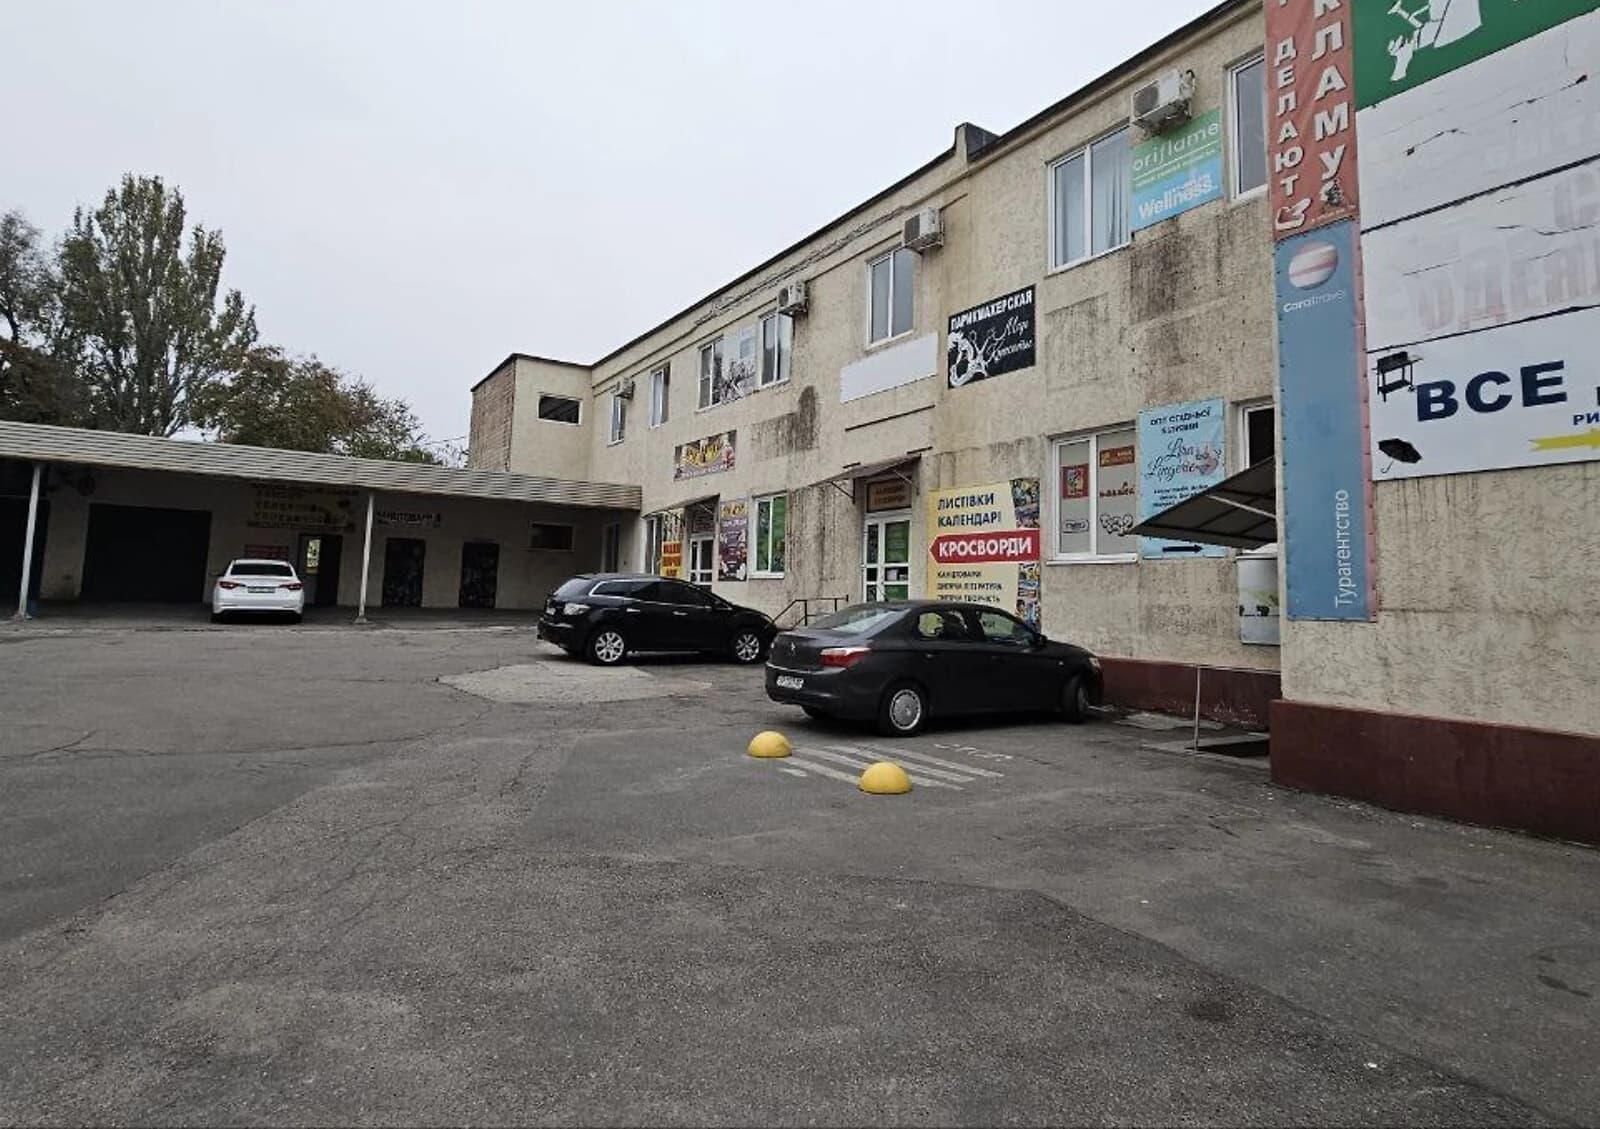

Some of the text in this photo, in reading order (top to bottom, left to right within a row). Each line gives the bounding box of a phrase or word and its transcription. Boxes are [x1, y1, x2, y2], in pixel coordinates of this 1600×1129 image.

[1273, 35, 1304, 196] ДЕЛАЮТ
[1132, 122, 1218, 171] oriflame
[950, 289, 1033, 331] ПАРИКМАХЕРСКАЯ
[1417, 360, 1568, 422] ВСЕ
[937, 492, 995, 511] ЛИСТІВКИ
[937, 511, 1002, 528] КАЛЕНДАРІ
[938, 536, 1033, 557] КРОСВОРДИ
[1334, 489, 1359, 608] Турагентство
